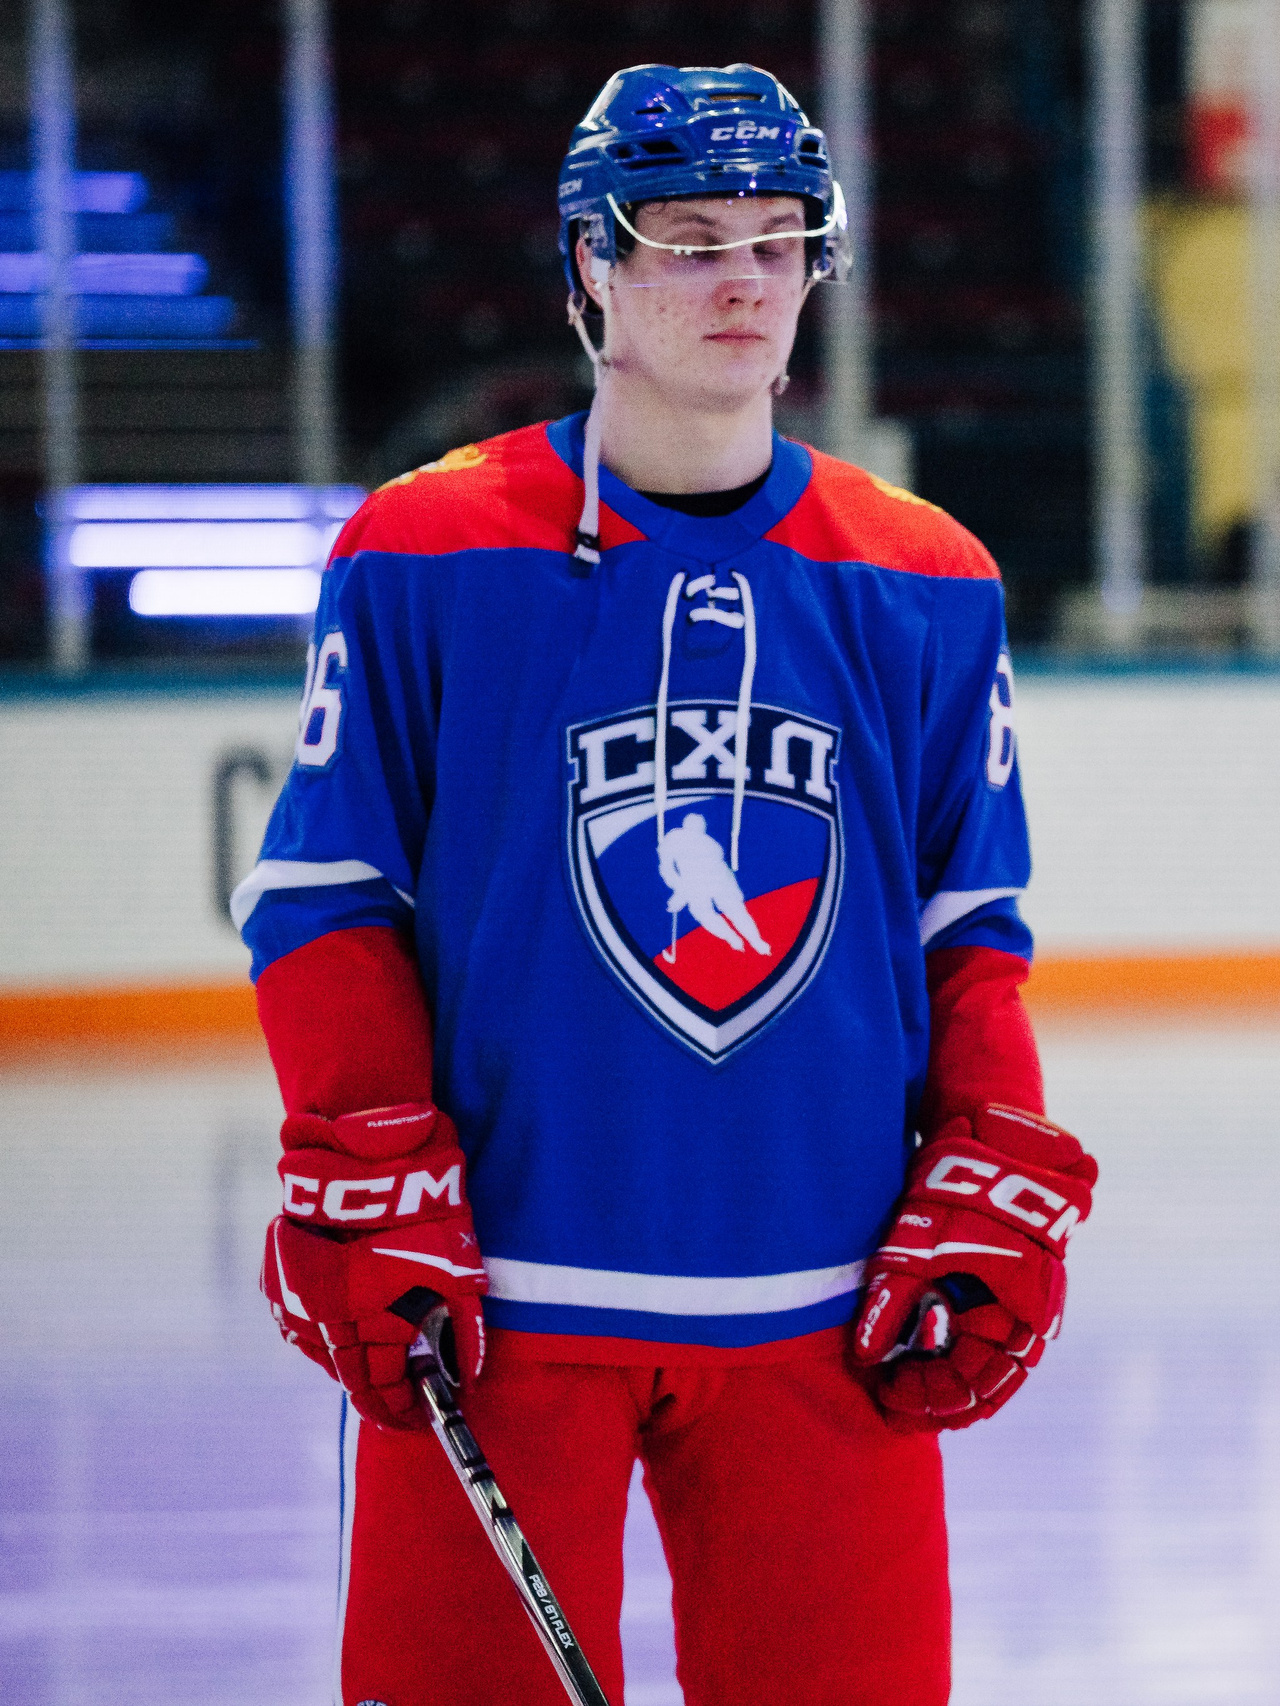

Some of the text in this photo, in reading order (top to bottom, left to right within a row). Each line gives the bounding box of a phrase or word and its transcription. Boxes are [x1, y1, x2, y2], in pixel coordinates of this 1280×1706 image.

[710, 126, 780, 141] CCM
[579, 709, 833, 804] СХП
[283, 1164, 462, 1221] CCM
[551, 1620, 574, 1649] FLEX
